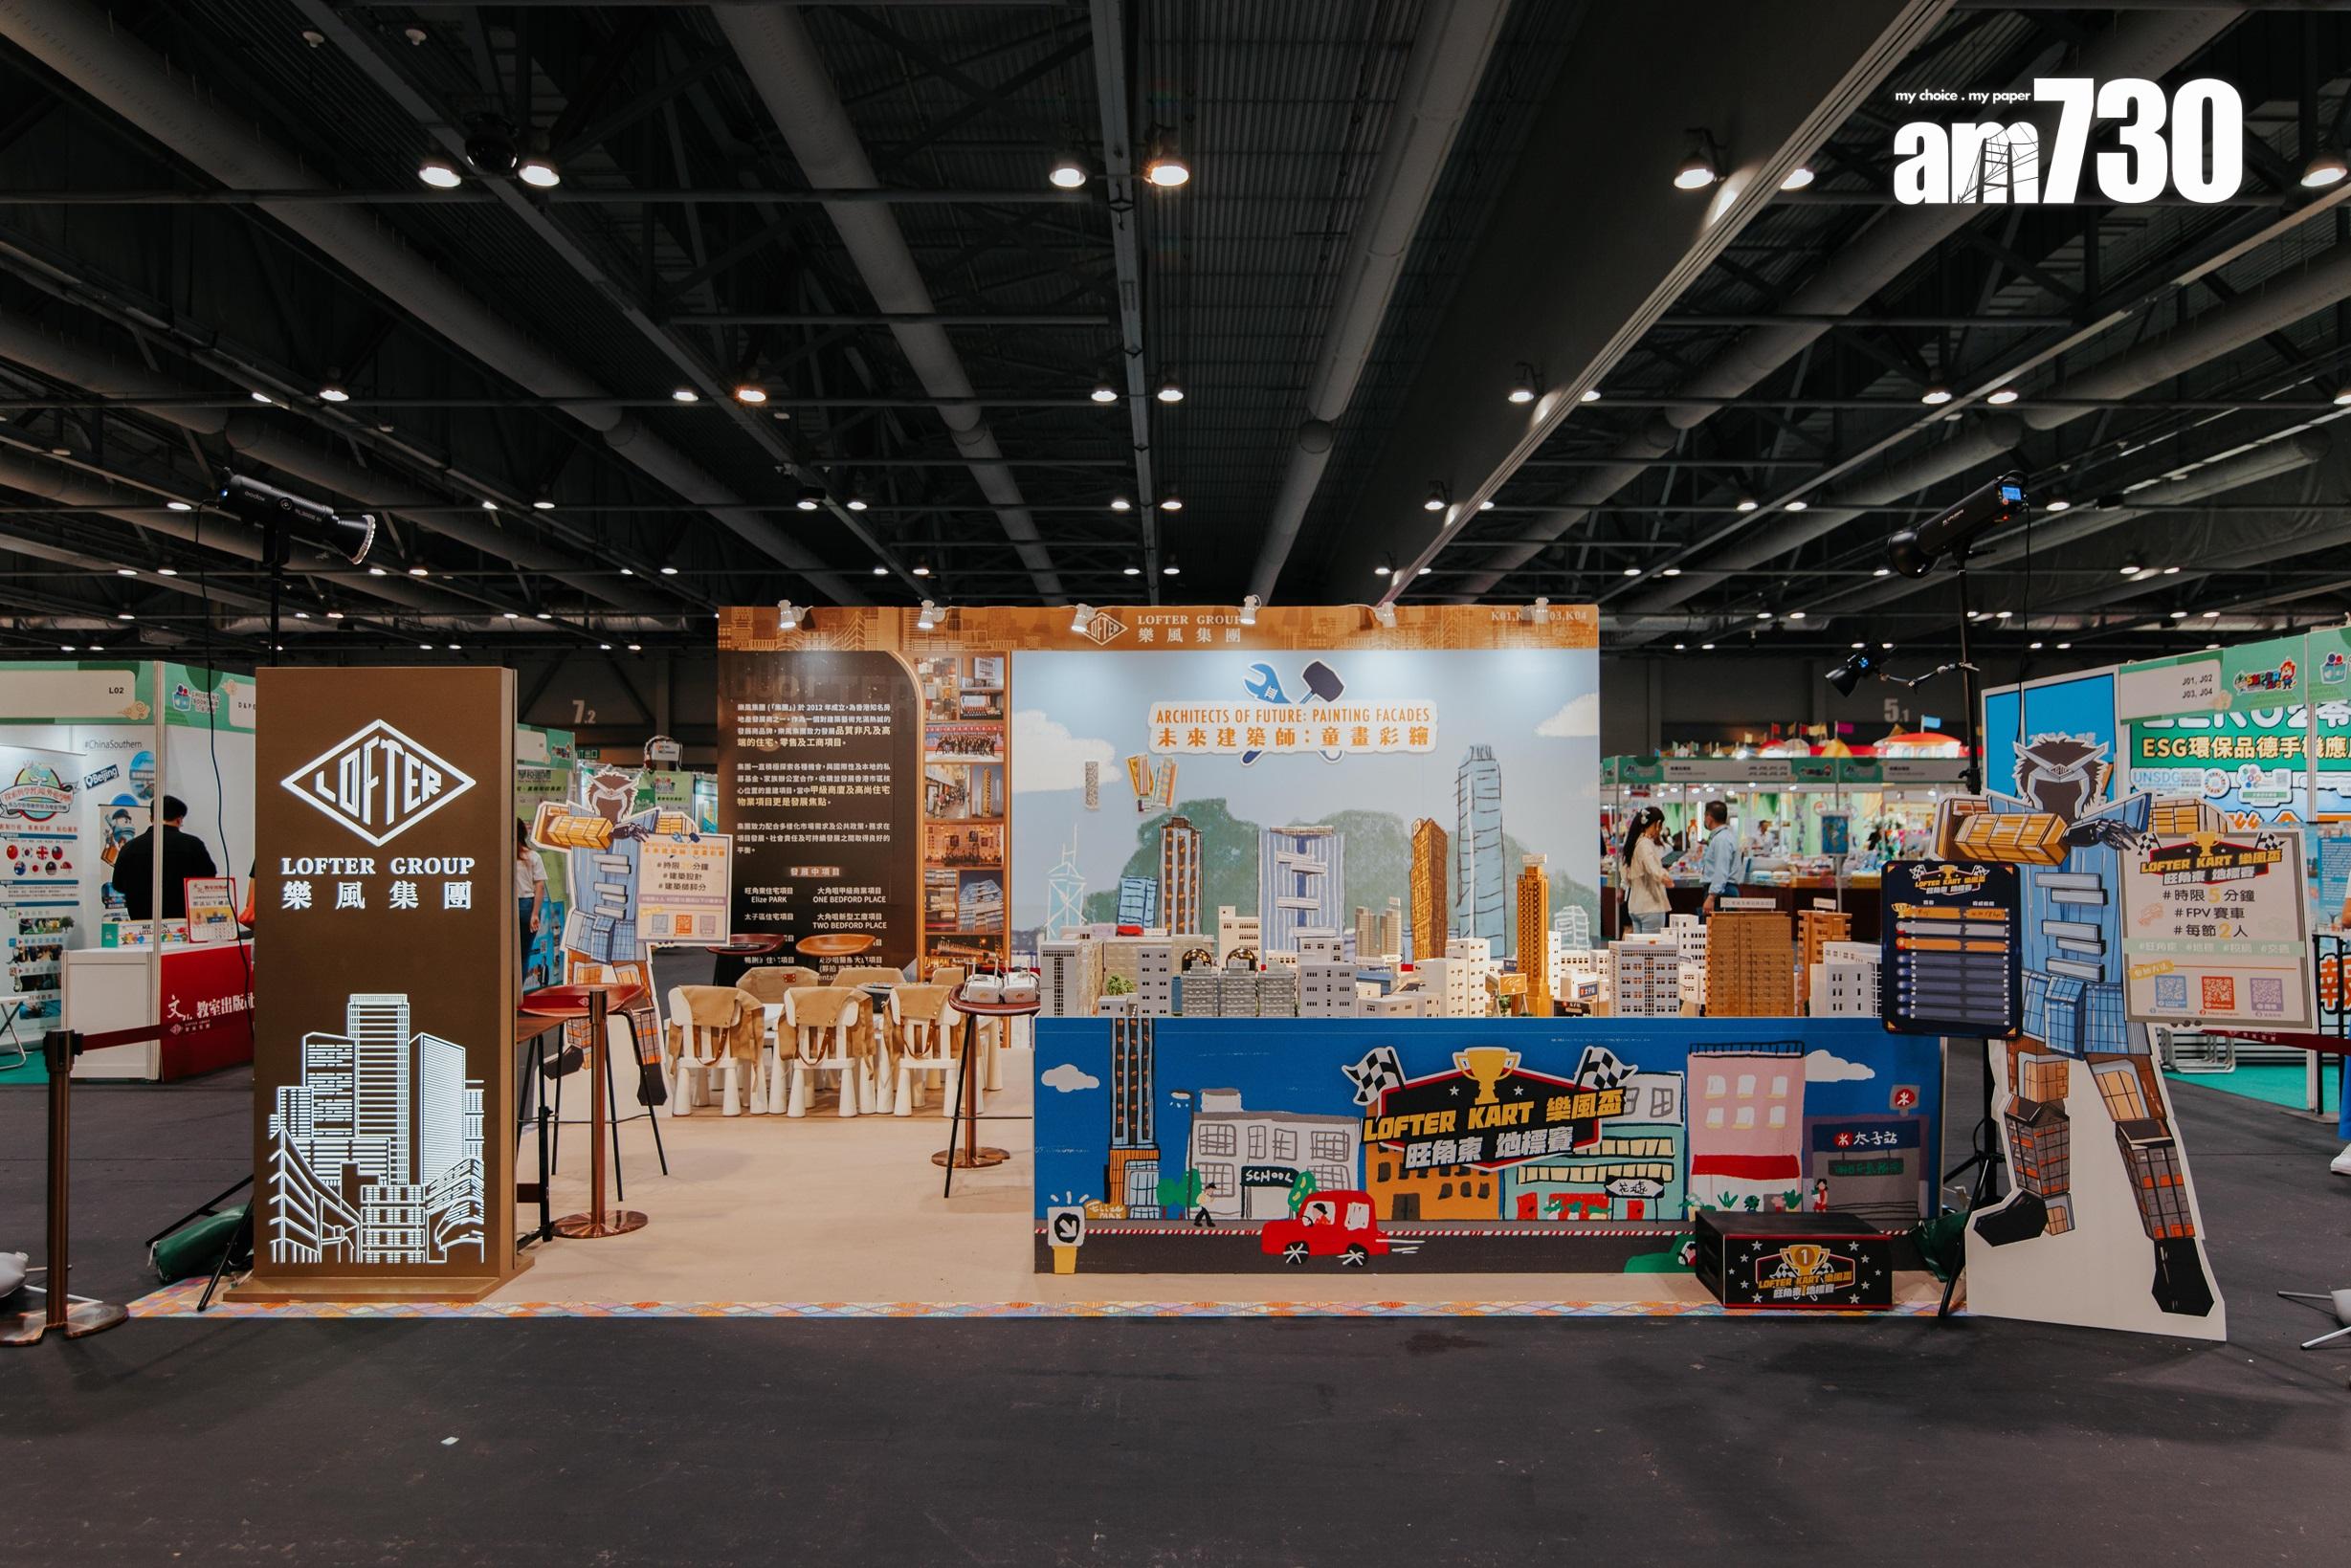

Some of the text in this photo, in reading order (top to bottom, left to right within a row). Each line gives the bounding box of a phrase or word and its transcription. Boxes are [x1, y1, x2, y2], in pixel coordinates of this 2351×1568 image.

[1138, 615, 1188, 625] LOFTER
[1138, 627, 1241, 643] 樂風集團
[2199, 674, 2213, 684] J02
[2199, 687, 2213, 697] J04
[572, 699, 596, 724] 7.2
[1156, 708, 1431, 723] ARCHITECTS OF FUTURE: PAINTING FACADES
[1883, 697, 1909, 723] 5.1
[84, 740, 143, 750] #ChinaSouthern
[2142, 735, 2351, 759] ESG環保品德手機應
[92, 765, 119, 785] Beijing
[314, 738, 443, 826] LOFTER
[280, 857, 476, 875] LOFTER GROUP
[2140, 858, 2190, 873] LOFTER
[2197, 855, 2232, 869] KART
[281, 879, 474, 910] 樂風集團
[1364, 1090, 1625, 1141] LOFTER KART 樂風盃
[1406, 1126, 1574, 1168] 旺角東 地標賽
[1245, 1169, 1294, 1183] SCHOOL
[1800, 1248, 1808, 1264] 1
[1758, 1276, 1792, 1290] LOFTER
[1795, 1274, 1823, 1286] KART
